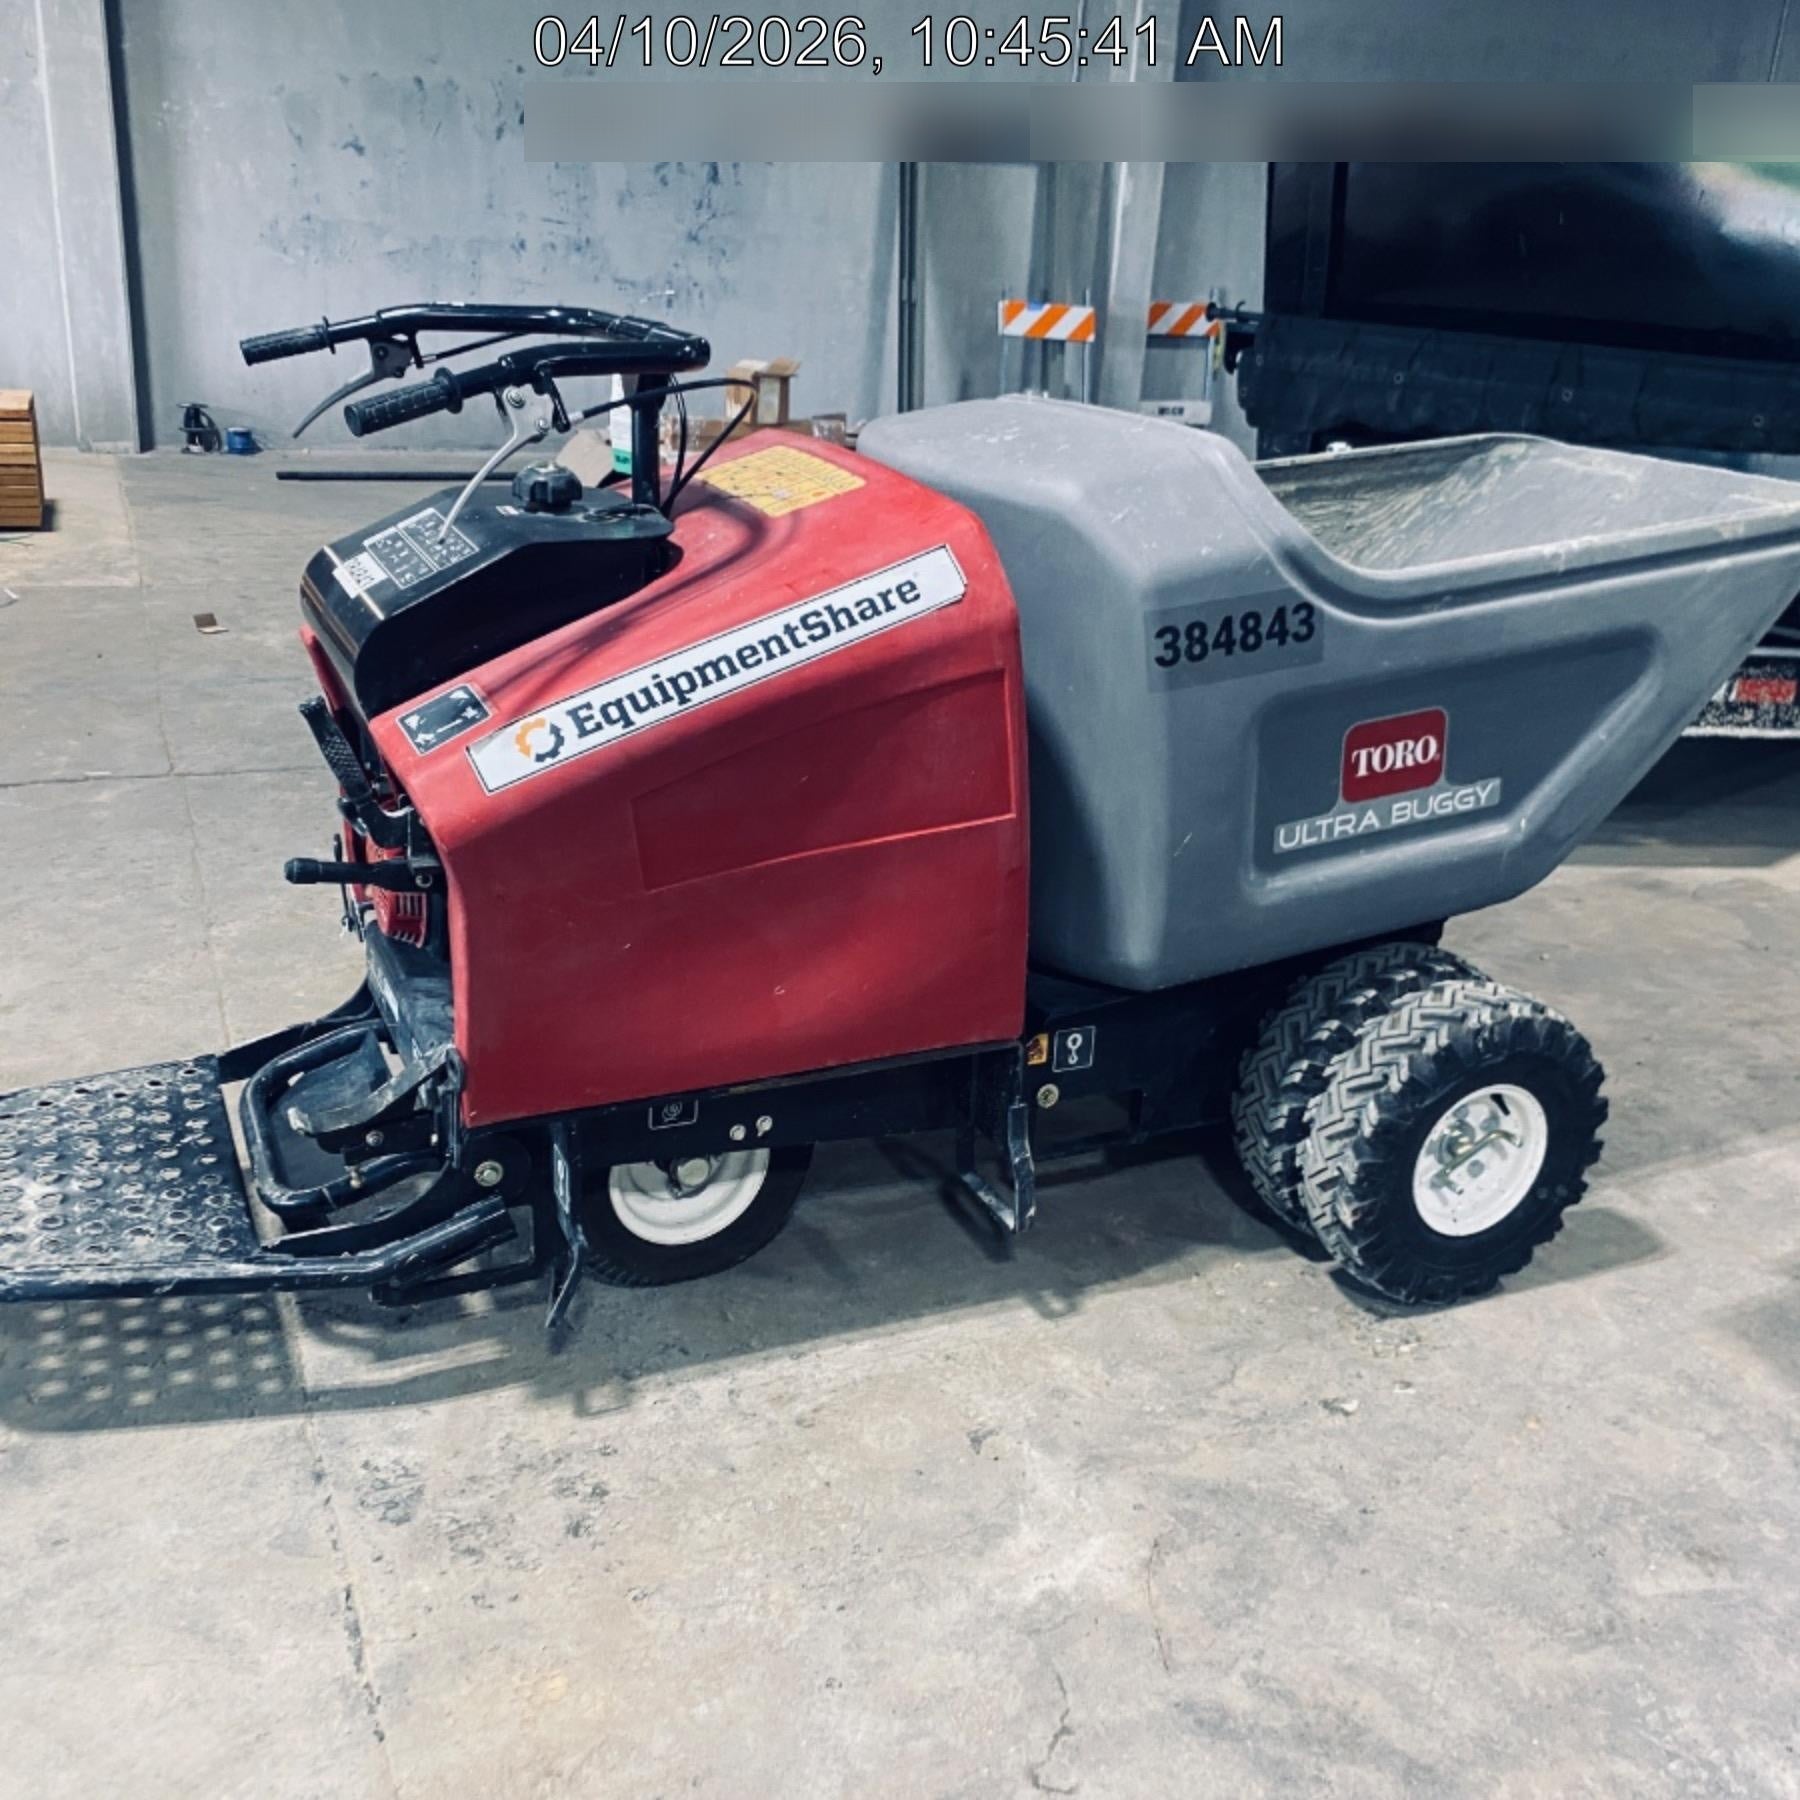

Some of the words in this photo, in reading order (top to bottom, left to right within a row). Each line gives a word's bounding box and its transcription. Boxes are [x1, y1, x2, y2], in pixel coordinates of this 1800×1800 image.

[566, 577, 922, 742] EquipmentShare
[1154, 602, 1316, 668] 384843
[1351, 735, 1437, 777] TORO
[1278, 809, 1380, 848] ULTRA
[1391, 781, 1495, 826] BUGGY
